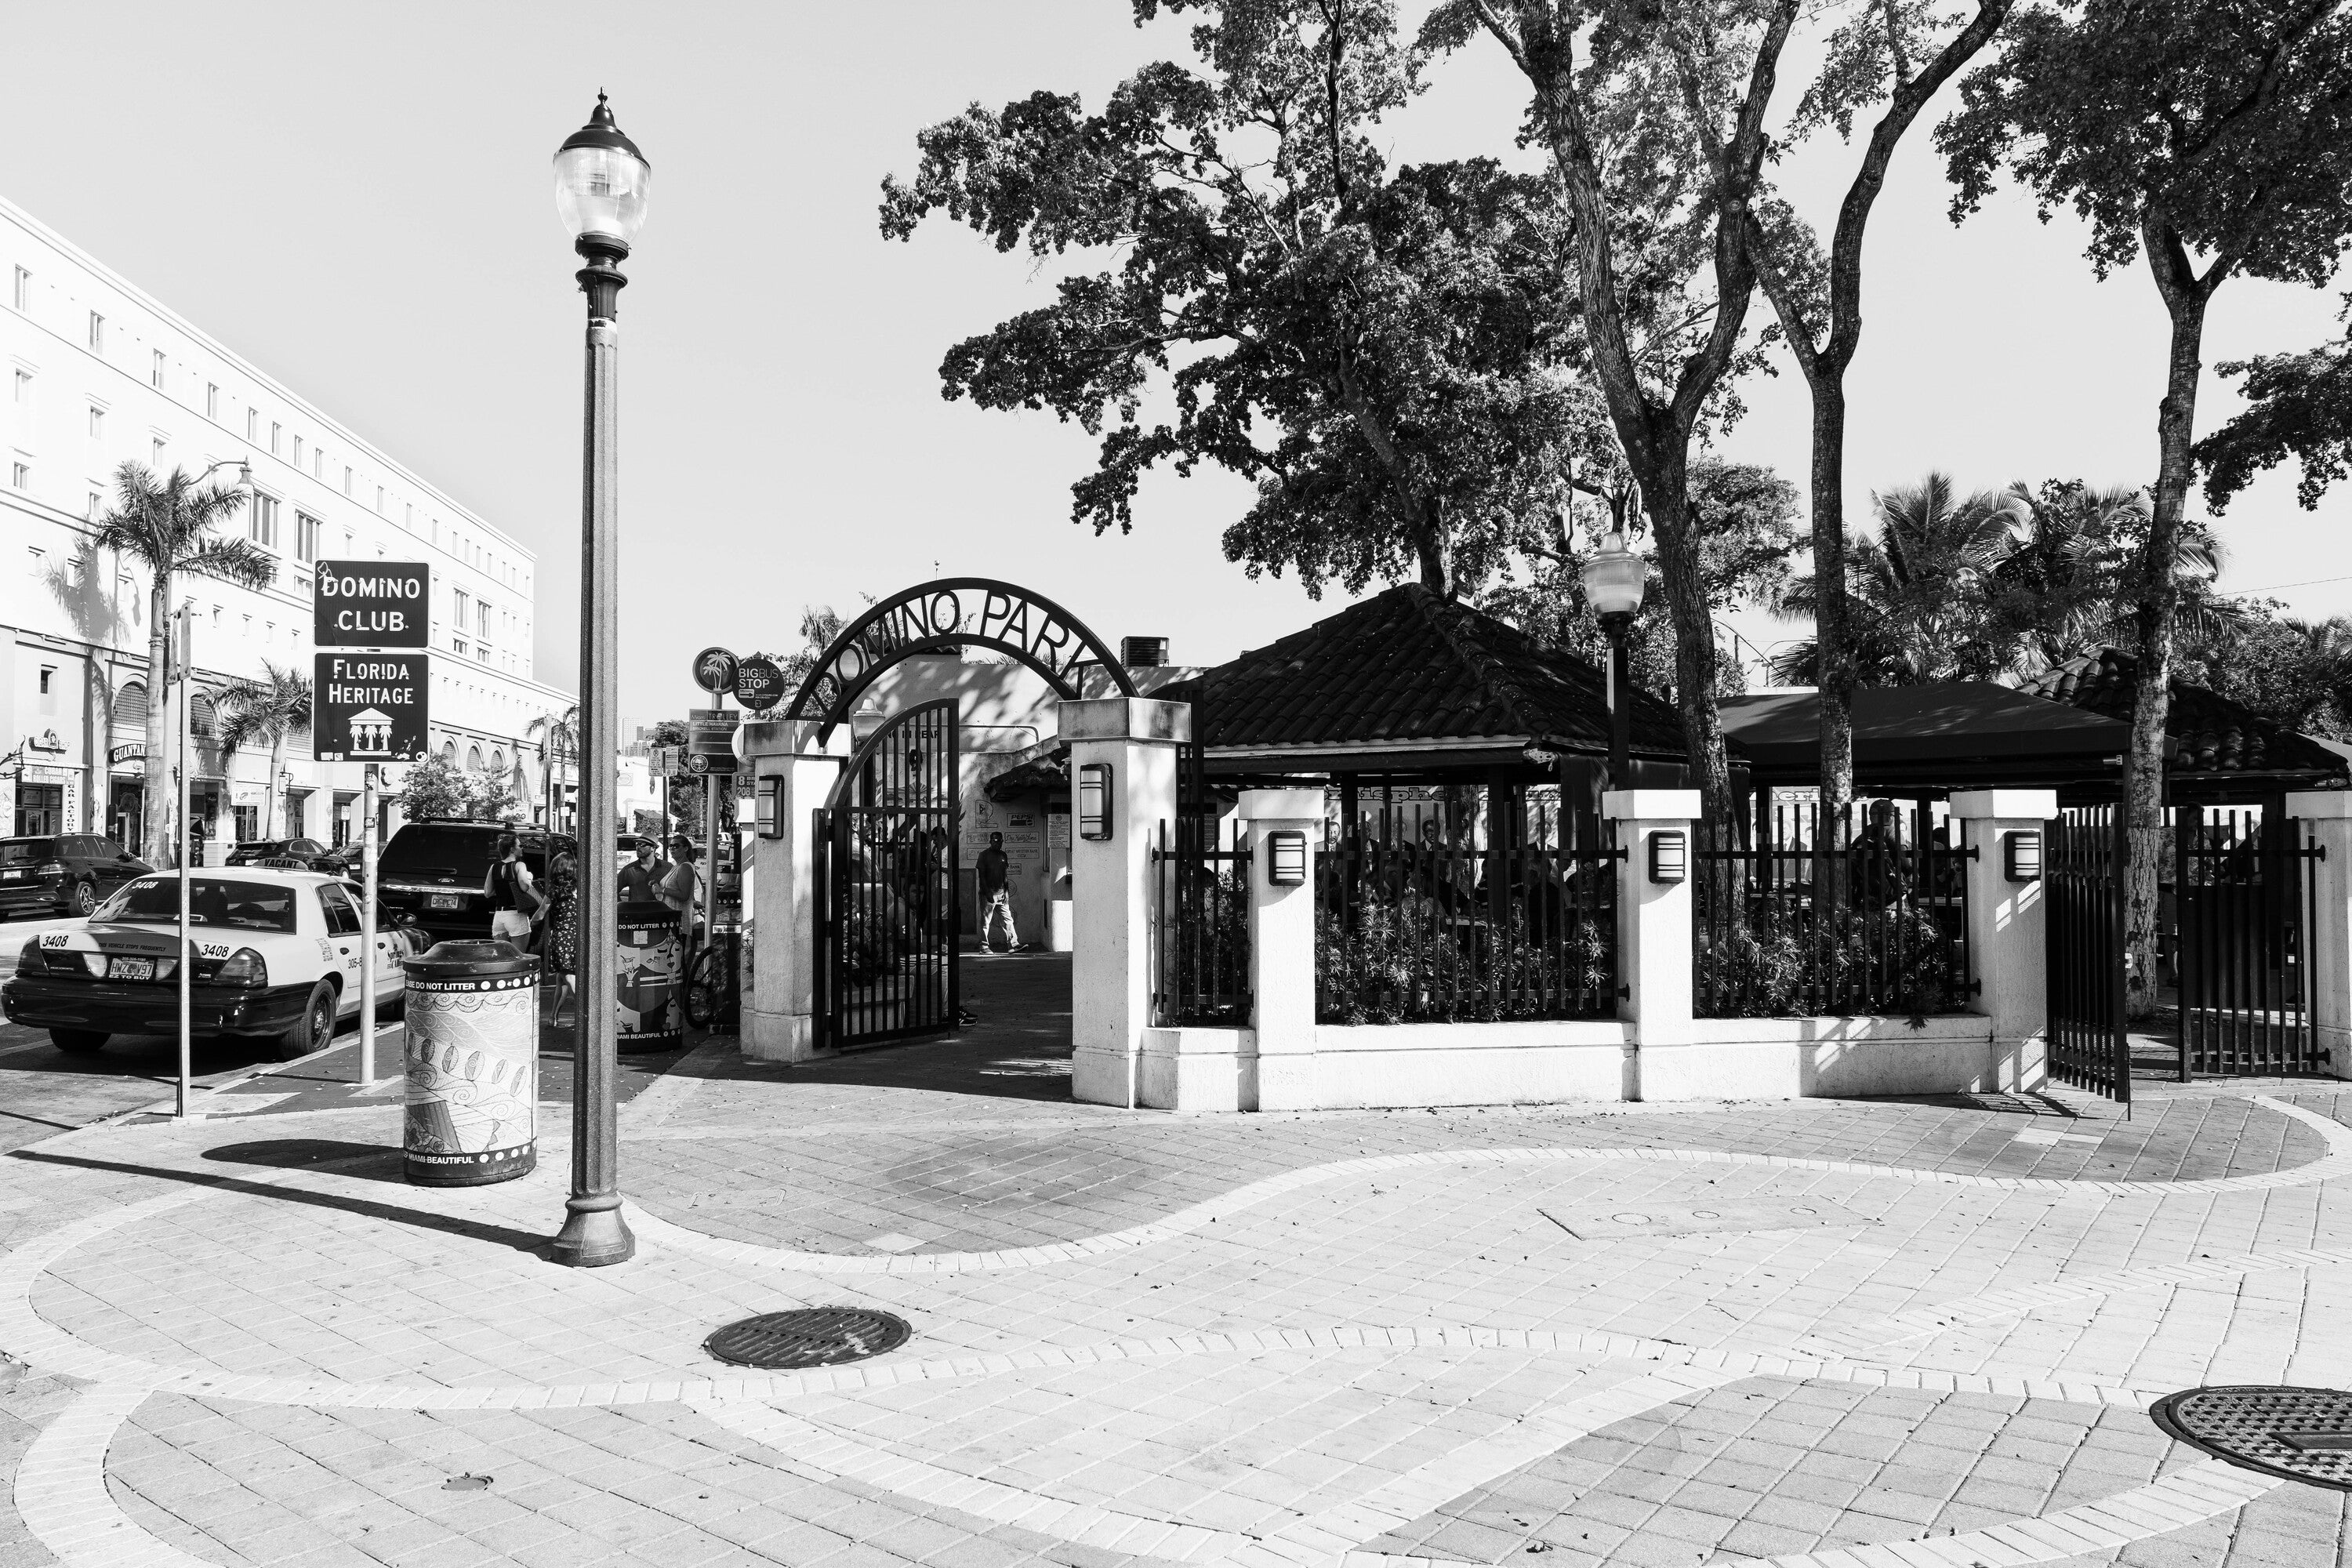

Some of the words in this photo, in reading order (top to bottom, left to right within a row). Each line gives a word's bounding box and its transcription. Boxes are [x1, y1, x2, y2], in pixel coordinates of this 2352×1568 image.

[323, 576, 420, 599] DOMINO
[338, 610, 405, 631] CLUB
[811, 590, 960, 714] DOMINO
[979, 590, 1105, 700] PARK
[333, 659, 409, 681] FLORIDA
[739, 678, 770, 688] STOP
[328, 683, 414, 704] HERITAGE
[113, 744, 147, 762] GUANTAN
[738, 775, 746, 786] 8
[737, 786, 751, 796] 208
[264, 858, 299, 869] VACANT
[42, 935, 69, 947] 3408
[201, 944, 230, 957] 3408
[408, 1153, 426, 1163] MIAMI
[426, 1156, 474, 1164] BEAUTIFUL
